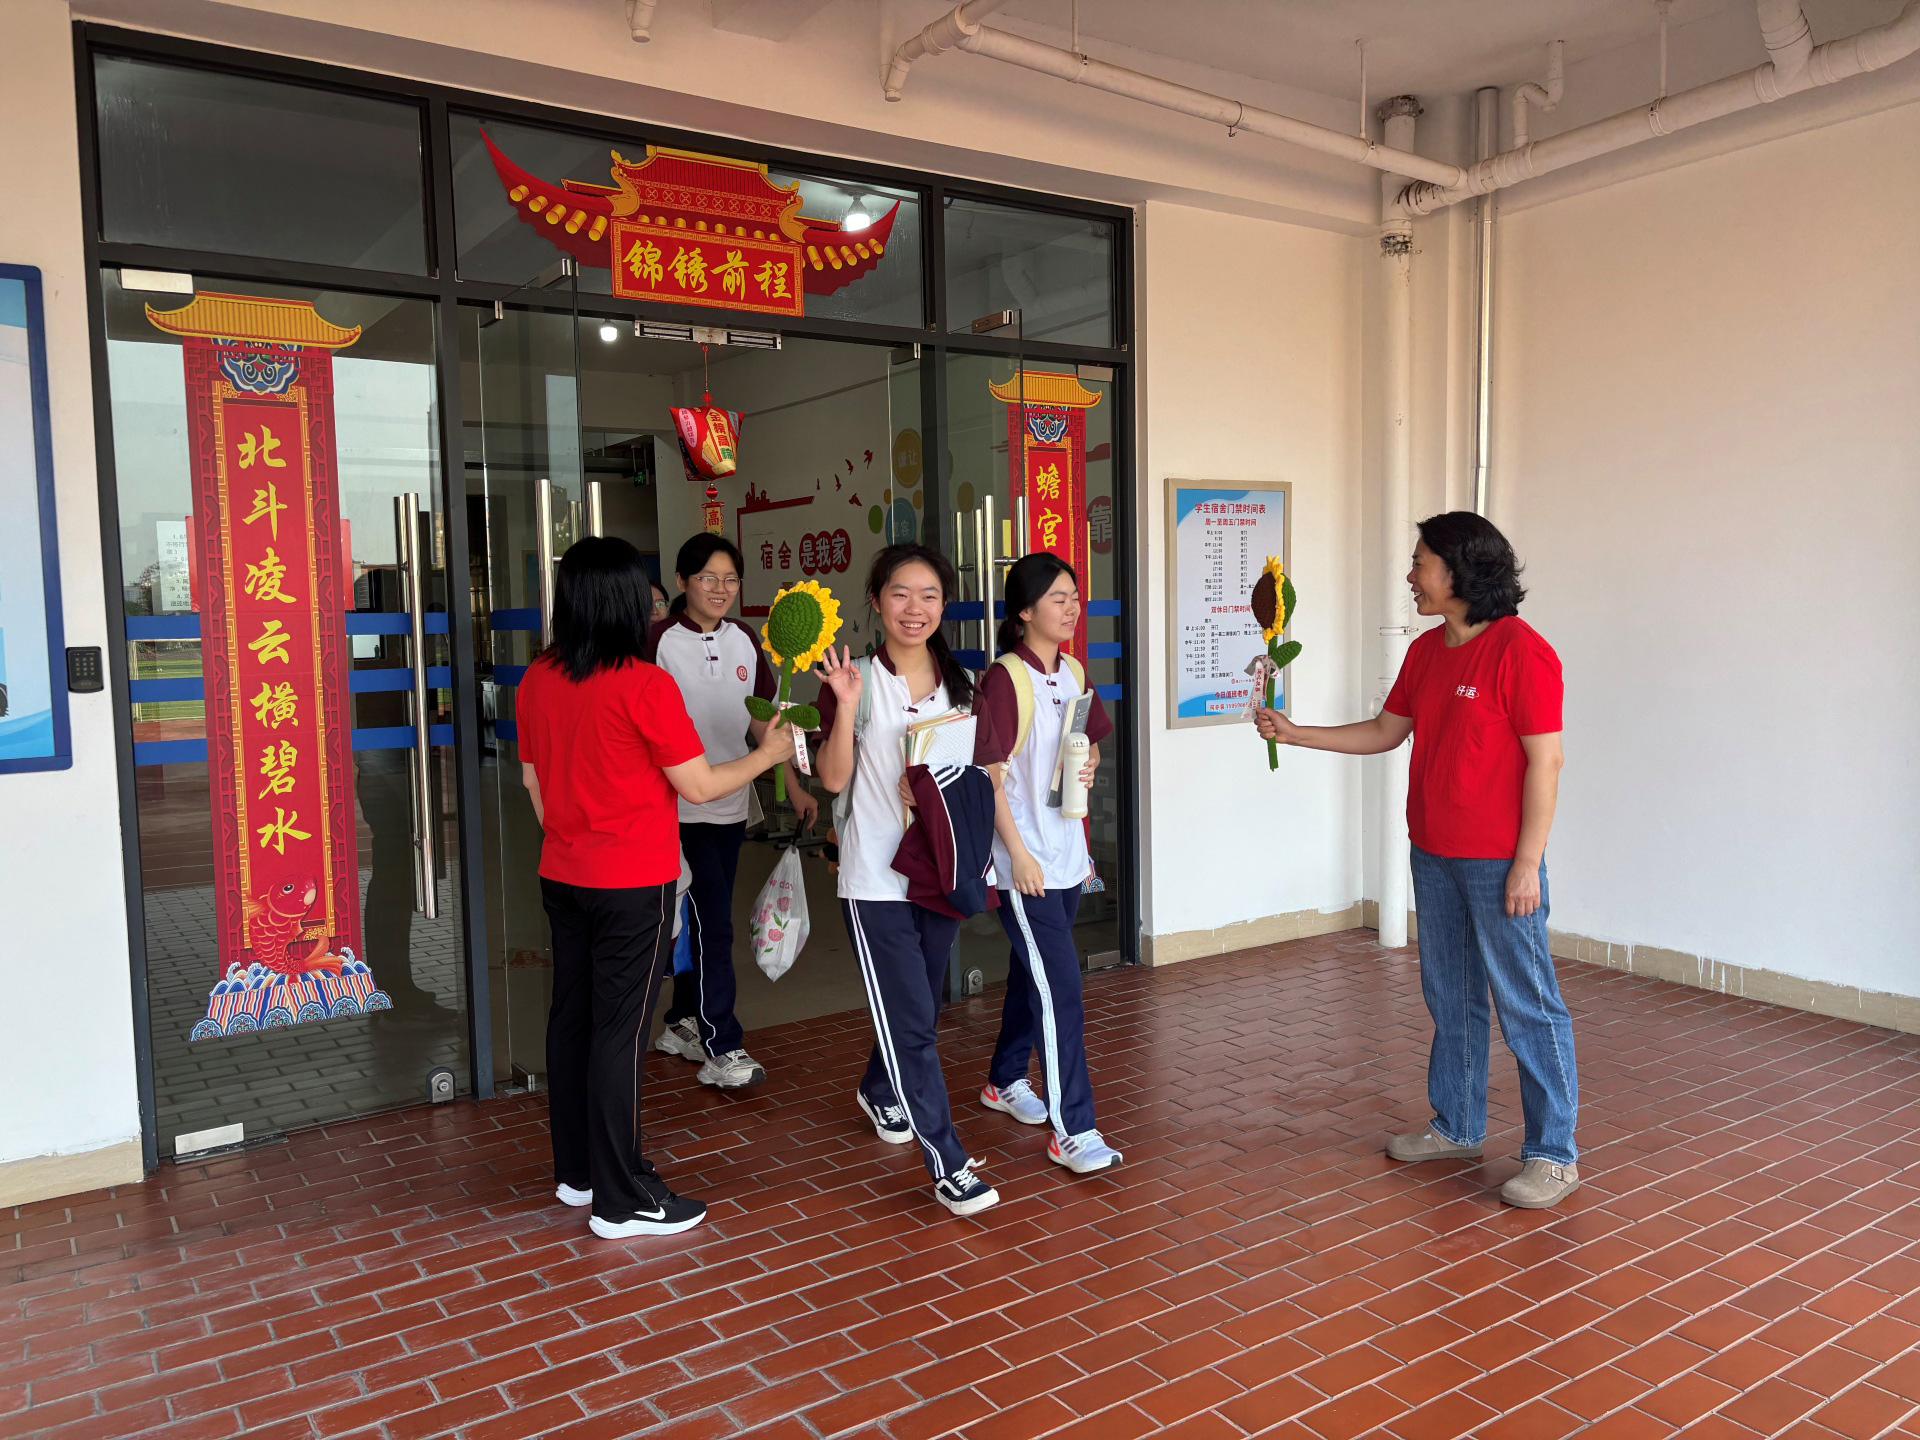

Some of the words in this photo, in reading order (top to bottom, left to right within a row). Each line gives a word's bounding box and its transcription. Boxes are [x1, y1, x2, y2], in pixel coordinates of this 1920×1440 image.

[622, 239, 792, 301] 锦绣前程
[709, 411, 735, 460] 金榜高粽
[1035, 462, 1063, 550] 蟾宫
[1195, 503, 1266, 515] 学生宿舍门禁时间表
[1205, 518, 1257, 527] 周一至周五门禁时间
[760, 534, 848, 570] 宿舍是我家
[236, 424, 312, 856] 北斗凌云横碧水
[1215, 689, 1249, 699] 今日值班老师
[1456, 684, 1478, 699] 好运
